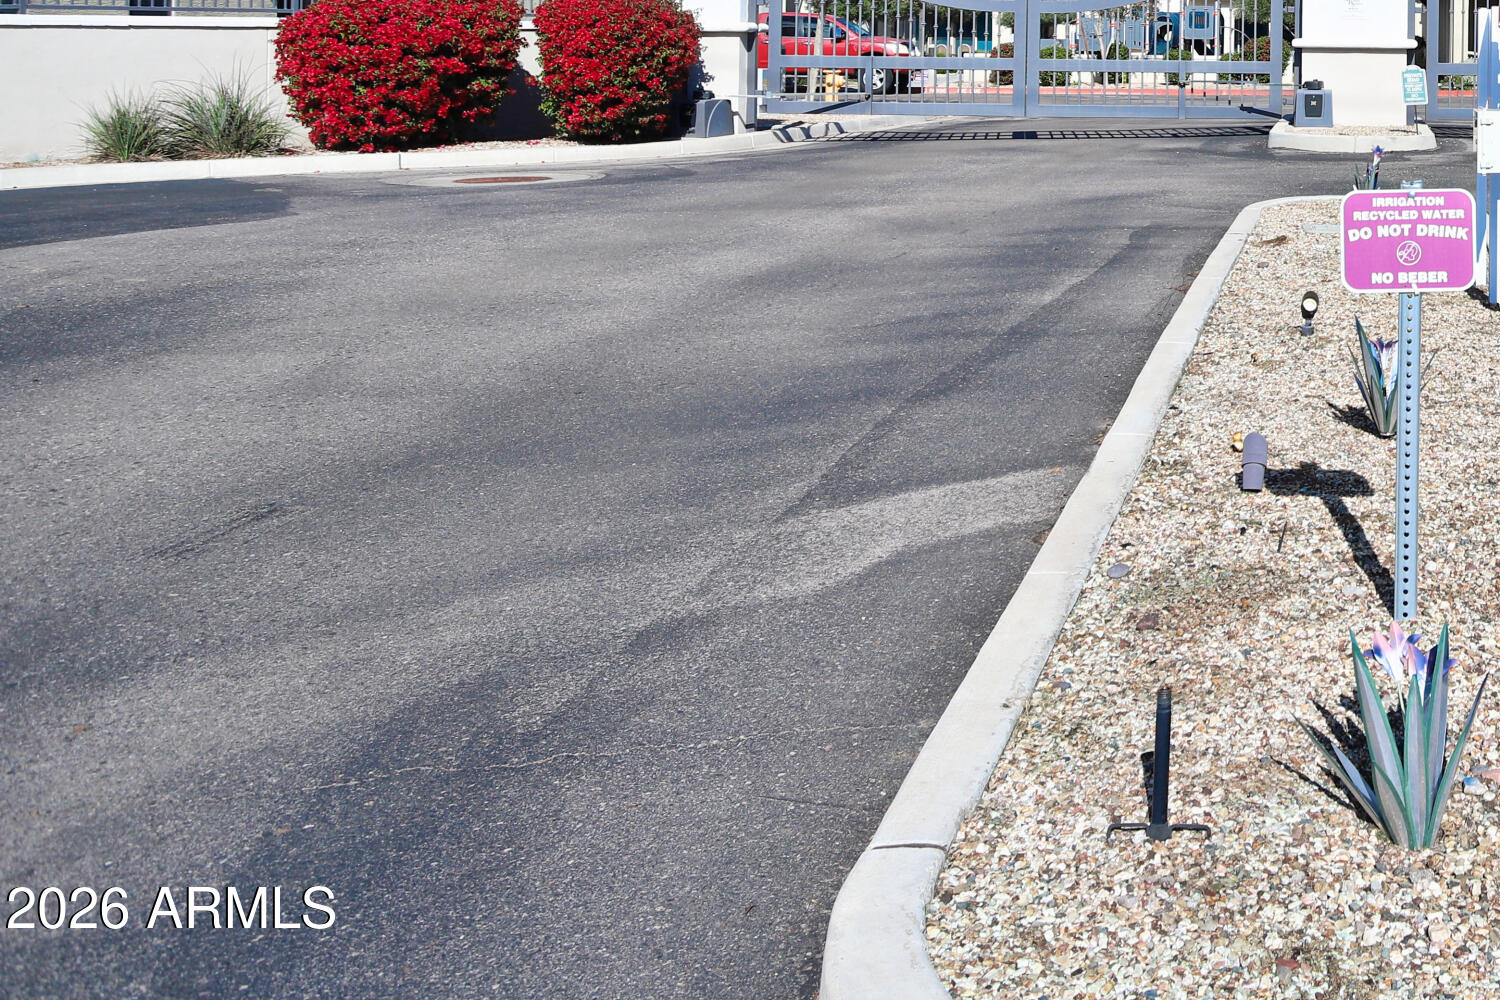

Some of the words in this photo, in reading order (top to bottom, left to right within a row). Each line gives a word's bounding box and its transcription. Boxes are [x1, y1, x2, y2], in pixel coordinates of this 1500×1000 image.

[1372, 196, 1445, 207] IRRIGATION
[1353, 210, 1418, 221] RECYCLED
[1421, 209, 1465, 219] WATER
[1347, 227, 1373, 242] DO
[1377, 224, 1412, 237] NOT
[1416, 224, 1469, 241] DRINK
[1371, 272, 1394, 284] NO
[1398, 271, 1448, 283] BEBER
